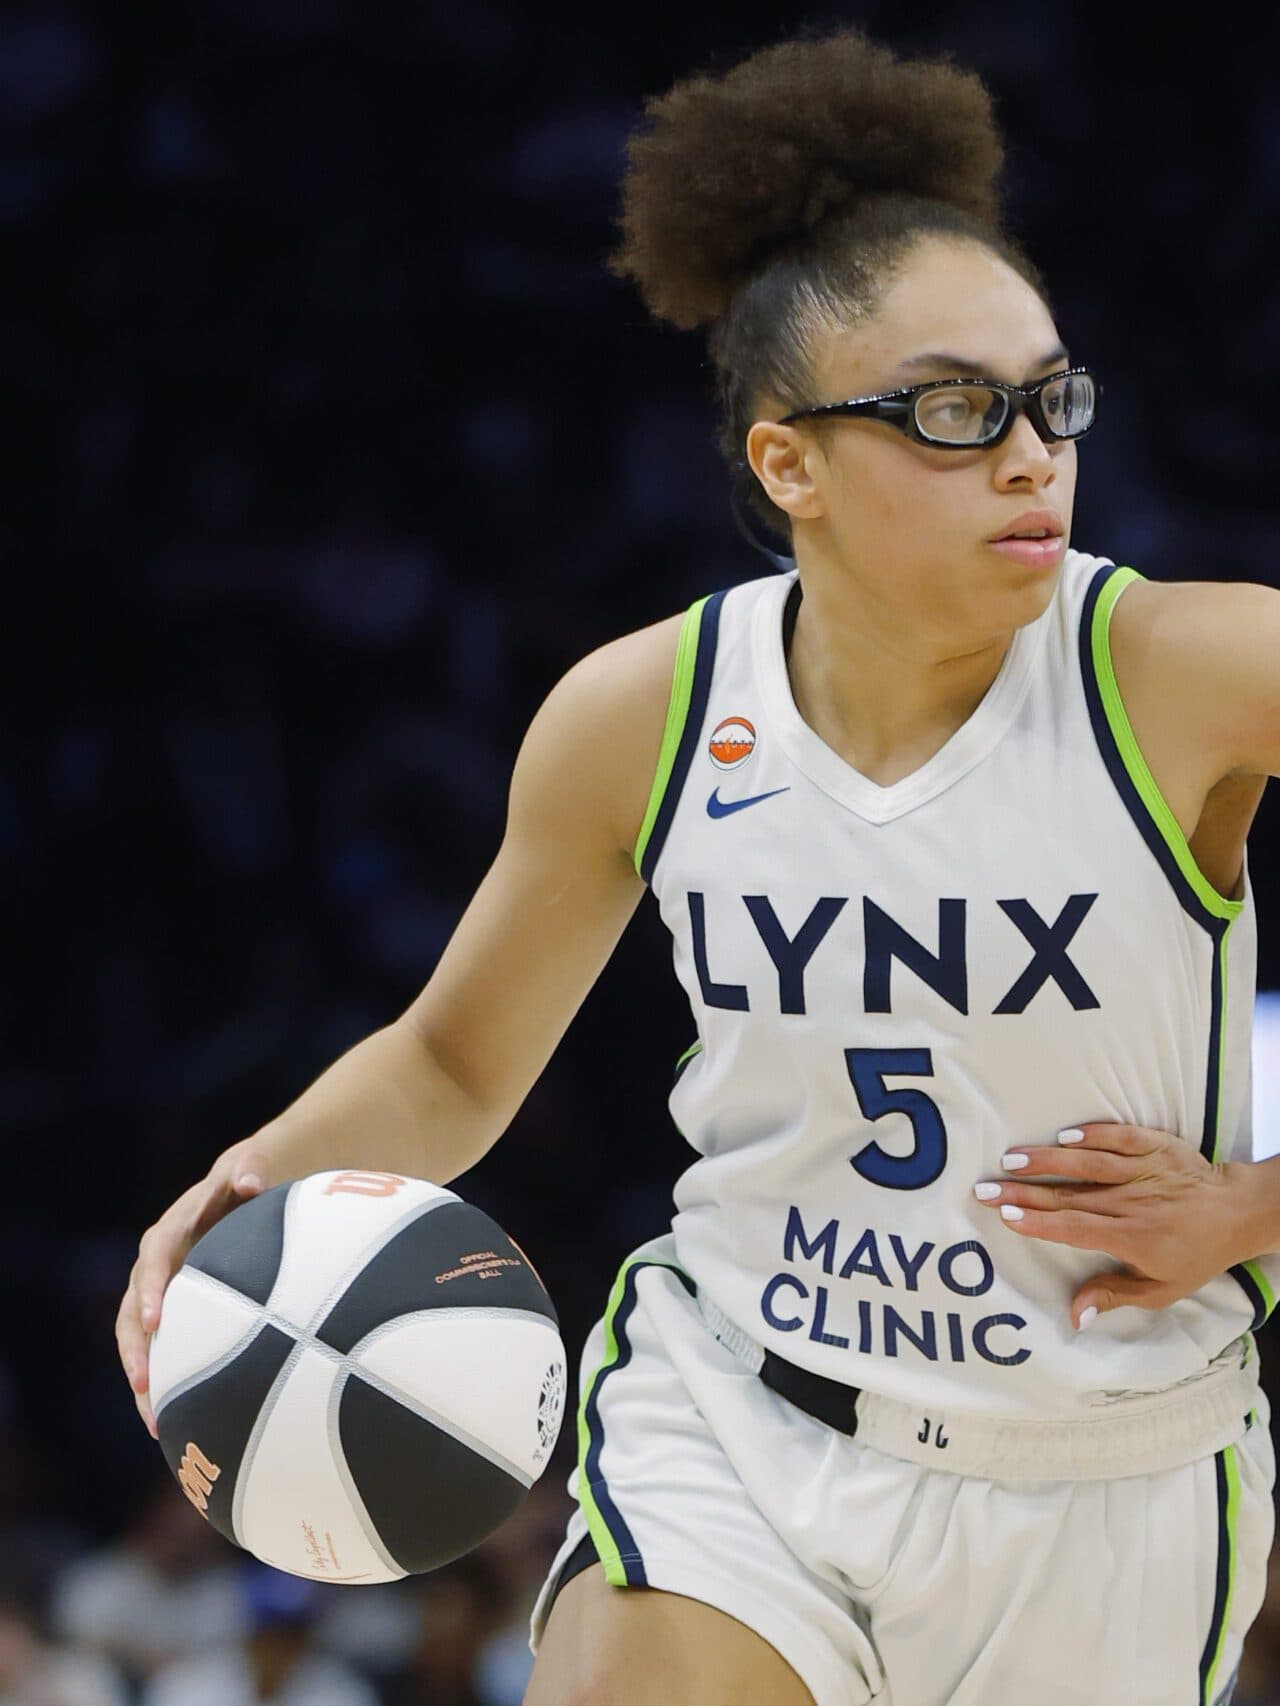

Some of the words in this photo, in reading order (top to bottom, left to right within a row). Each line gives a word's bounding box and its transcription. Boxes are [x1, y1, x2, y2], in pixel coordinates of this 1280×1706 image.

[687, 892, 1102, 1016] LYNX
[844, 1047, 948, 1190] 5
[783, 1206, 995, 1297] MAYO
[761, 1274, 1032, 1366] CLINIC
